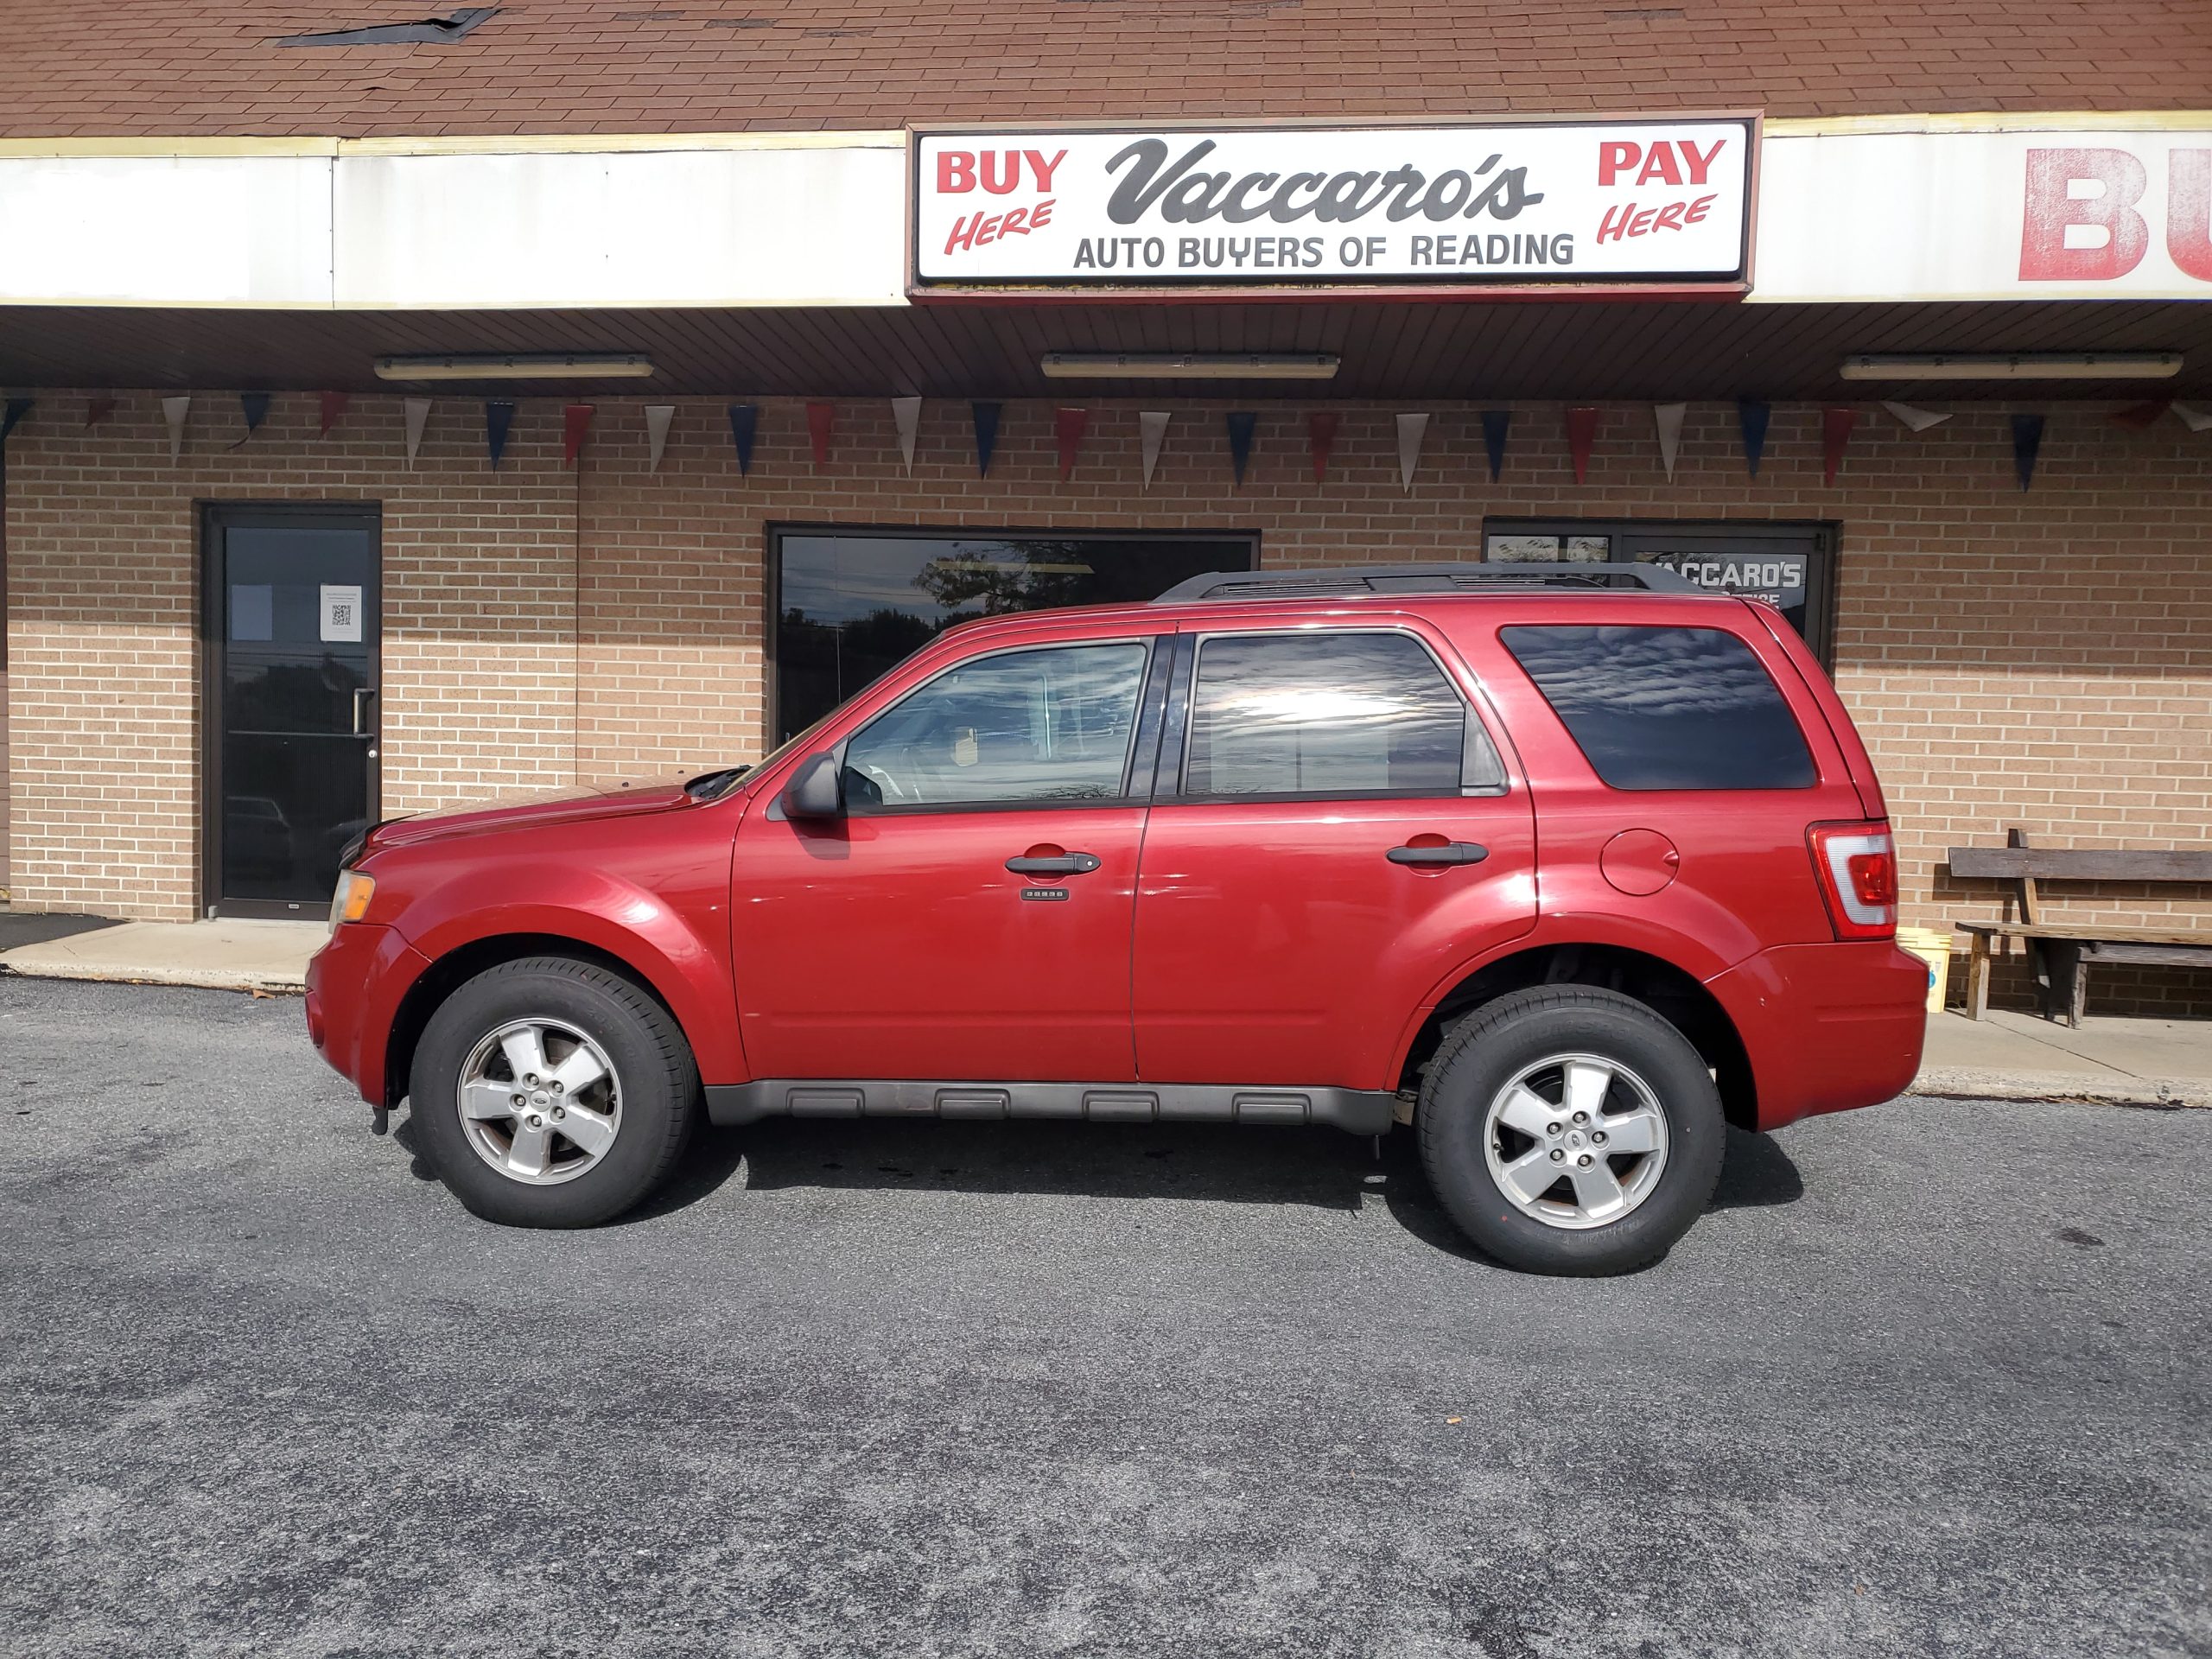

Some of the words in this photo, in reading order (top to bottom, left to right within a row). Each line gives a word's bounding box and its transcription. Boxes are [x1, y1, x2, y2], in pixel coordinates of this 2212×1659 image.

[937, 149, 1069, 194] BUY
[1104, 138, 1545, 225] Vaccaro's
[1598, 139, 1727, 187] PAY
[944, 199, 1057, 256] HERE
[1596, 193, 1719, 245] HERE
[1072, 236, 1166, 269] AUTO
[1178, 236, 1325, 268] BUYERS
[1339, 236, 1387, 267] OF
[1410, 232, 1574, 266] READING
